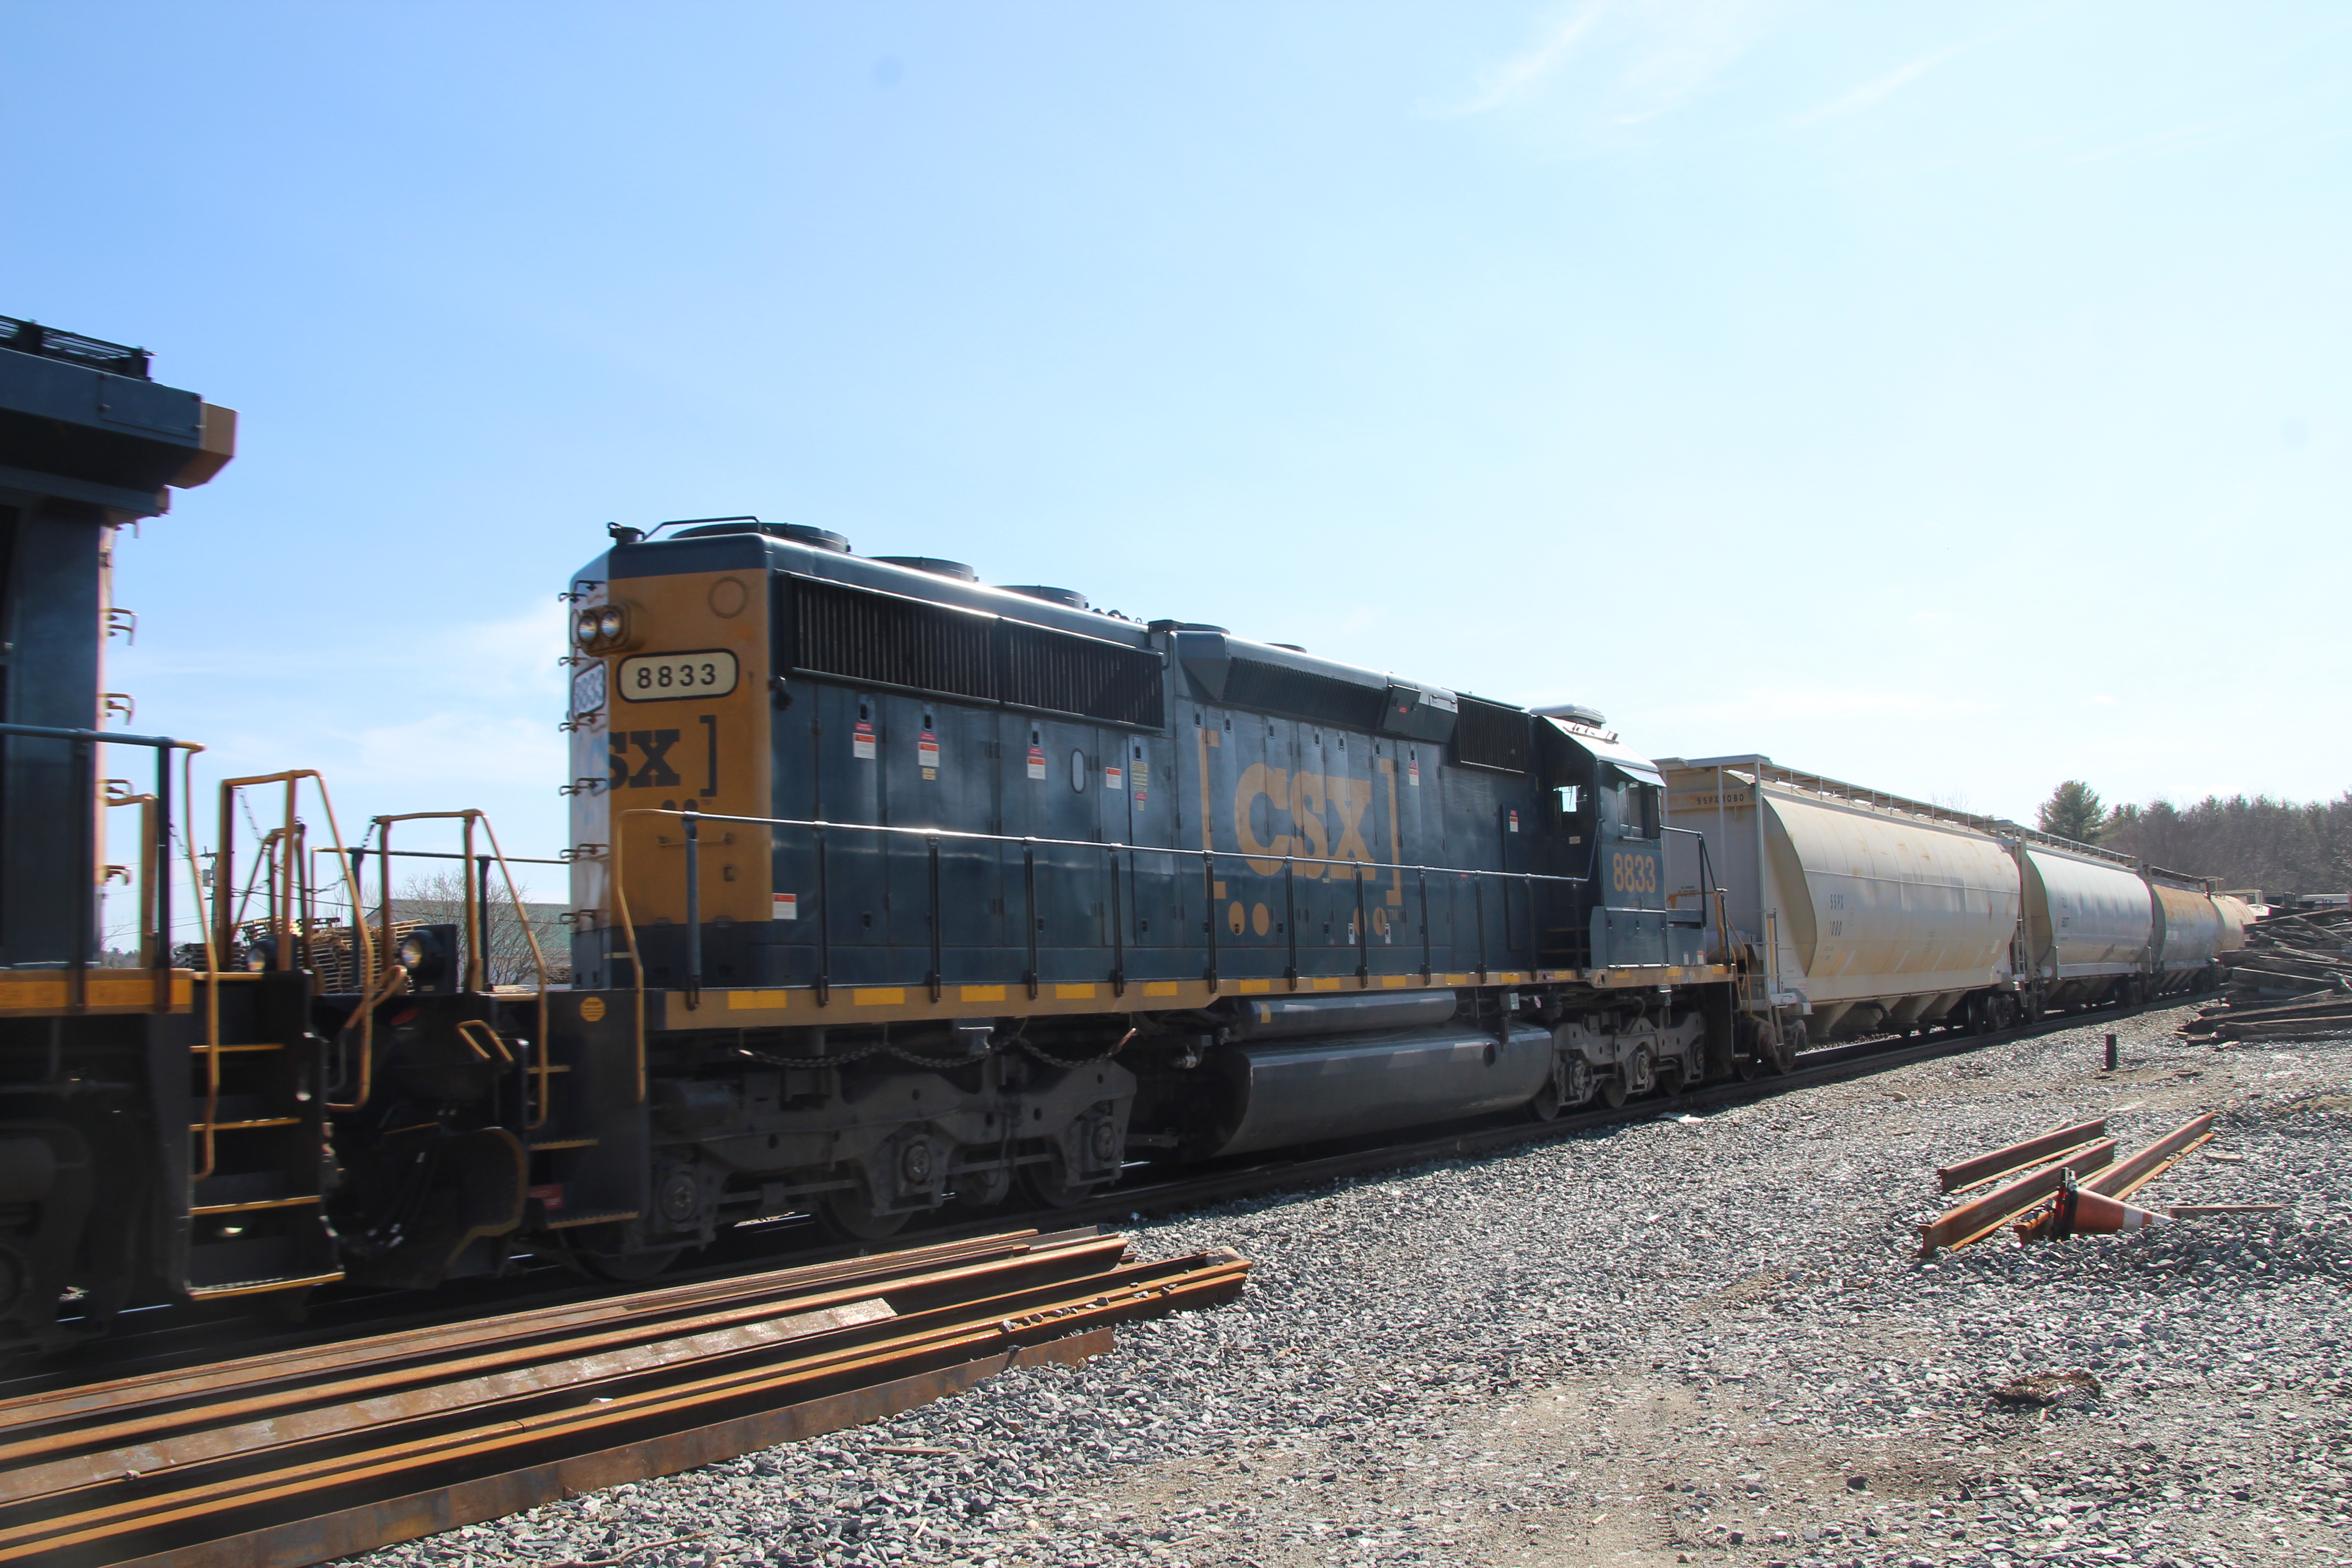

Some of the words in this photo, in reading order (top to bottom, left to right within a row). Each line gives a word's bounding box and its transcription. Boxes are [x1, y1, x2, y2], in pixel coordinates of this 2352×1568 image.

[637, 663, 716, 689] 8833
[1697, 795, 1720, 805] SSPX
[1722, 794, 1744, 803] 1080
[1234, 763, 1376, 881] CSX
[1613, 852, 1656, 893] 8833
[1830, 894, 1844, 910] SSPX
